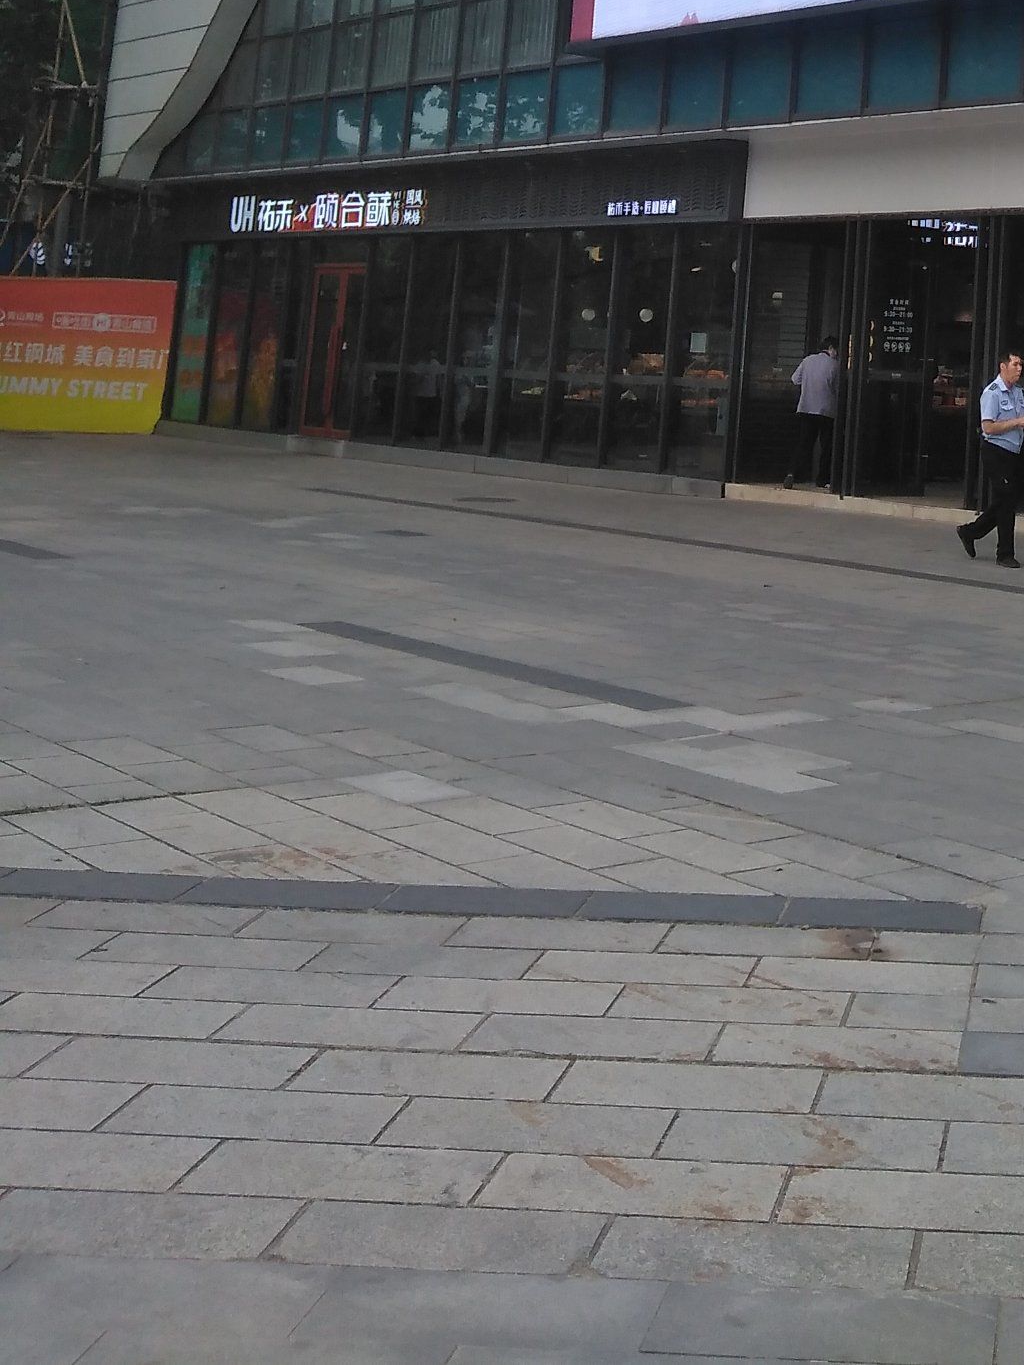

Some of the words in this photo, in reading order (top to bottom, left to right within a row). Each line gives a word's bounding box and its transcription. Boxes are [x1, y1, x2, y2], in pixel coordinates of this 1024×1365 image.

[0, 342, 66, 366] 红钢城
[66, 379, 150, 402] STREET
